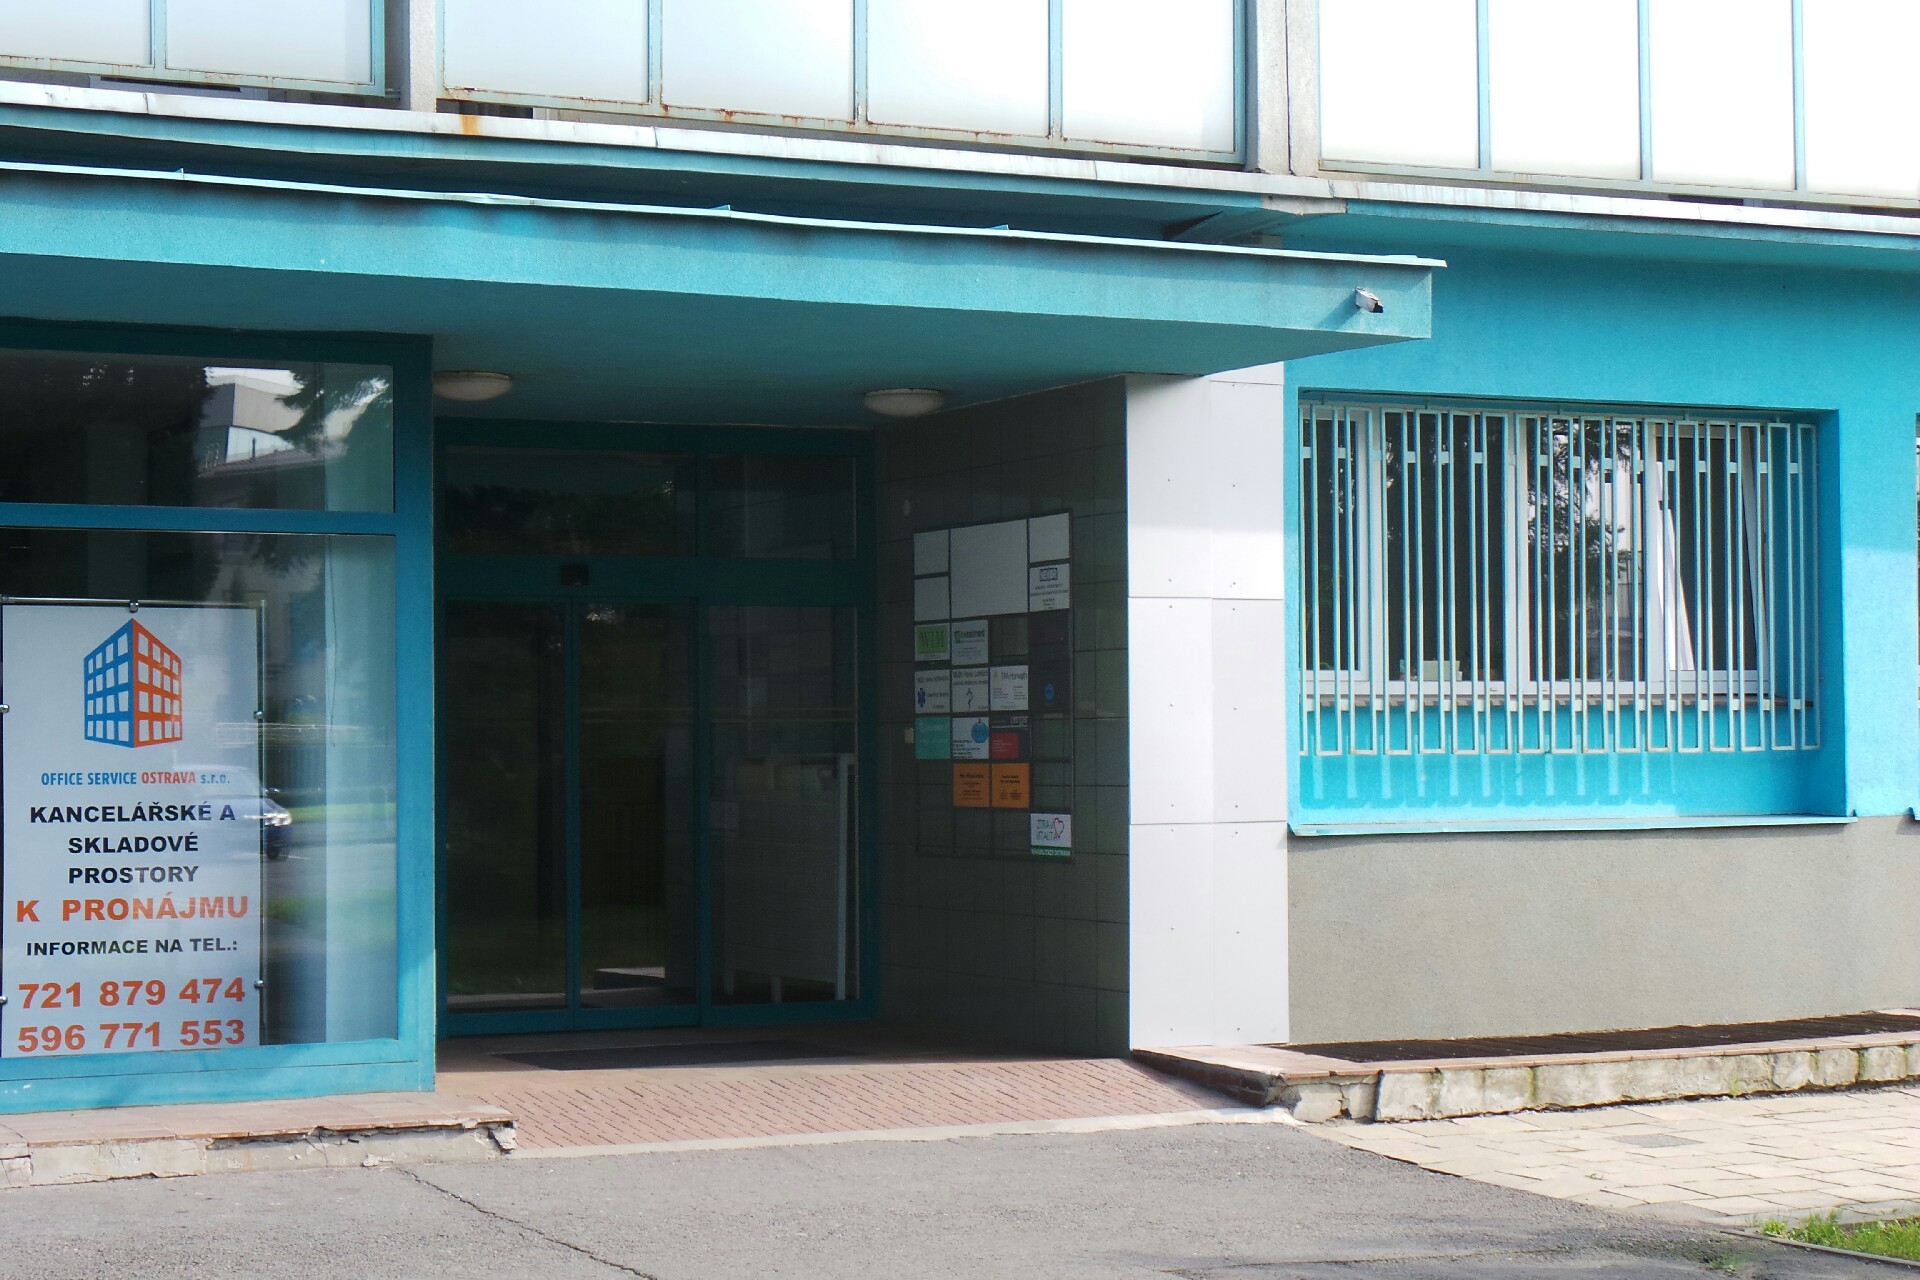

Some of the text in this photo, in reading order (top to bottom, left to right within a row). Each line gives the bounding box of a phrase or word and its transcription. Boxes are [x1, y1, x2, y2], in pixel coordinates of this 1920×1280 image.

[41, 771, 230, 785] OFFICE SERVICE OSTRAVA s.r.o.
[30, 801, 236, 823] KANCELÁŘSKÉ A
[68, 832, 199, 853] SKLADOVÉ
[69, 866, 199, 884] PROSTORY
[16, 892, 248, 922] K PRONÁJMU
[27, 938, 238, 955] INFORMACE NA TEL.:
[19, 977, 245, 1008] 721 879 474
[18, 1019, 245, 1052] 596 771 553
